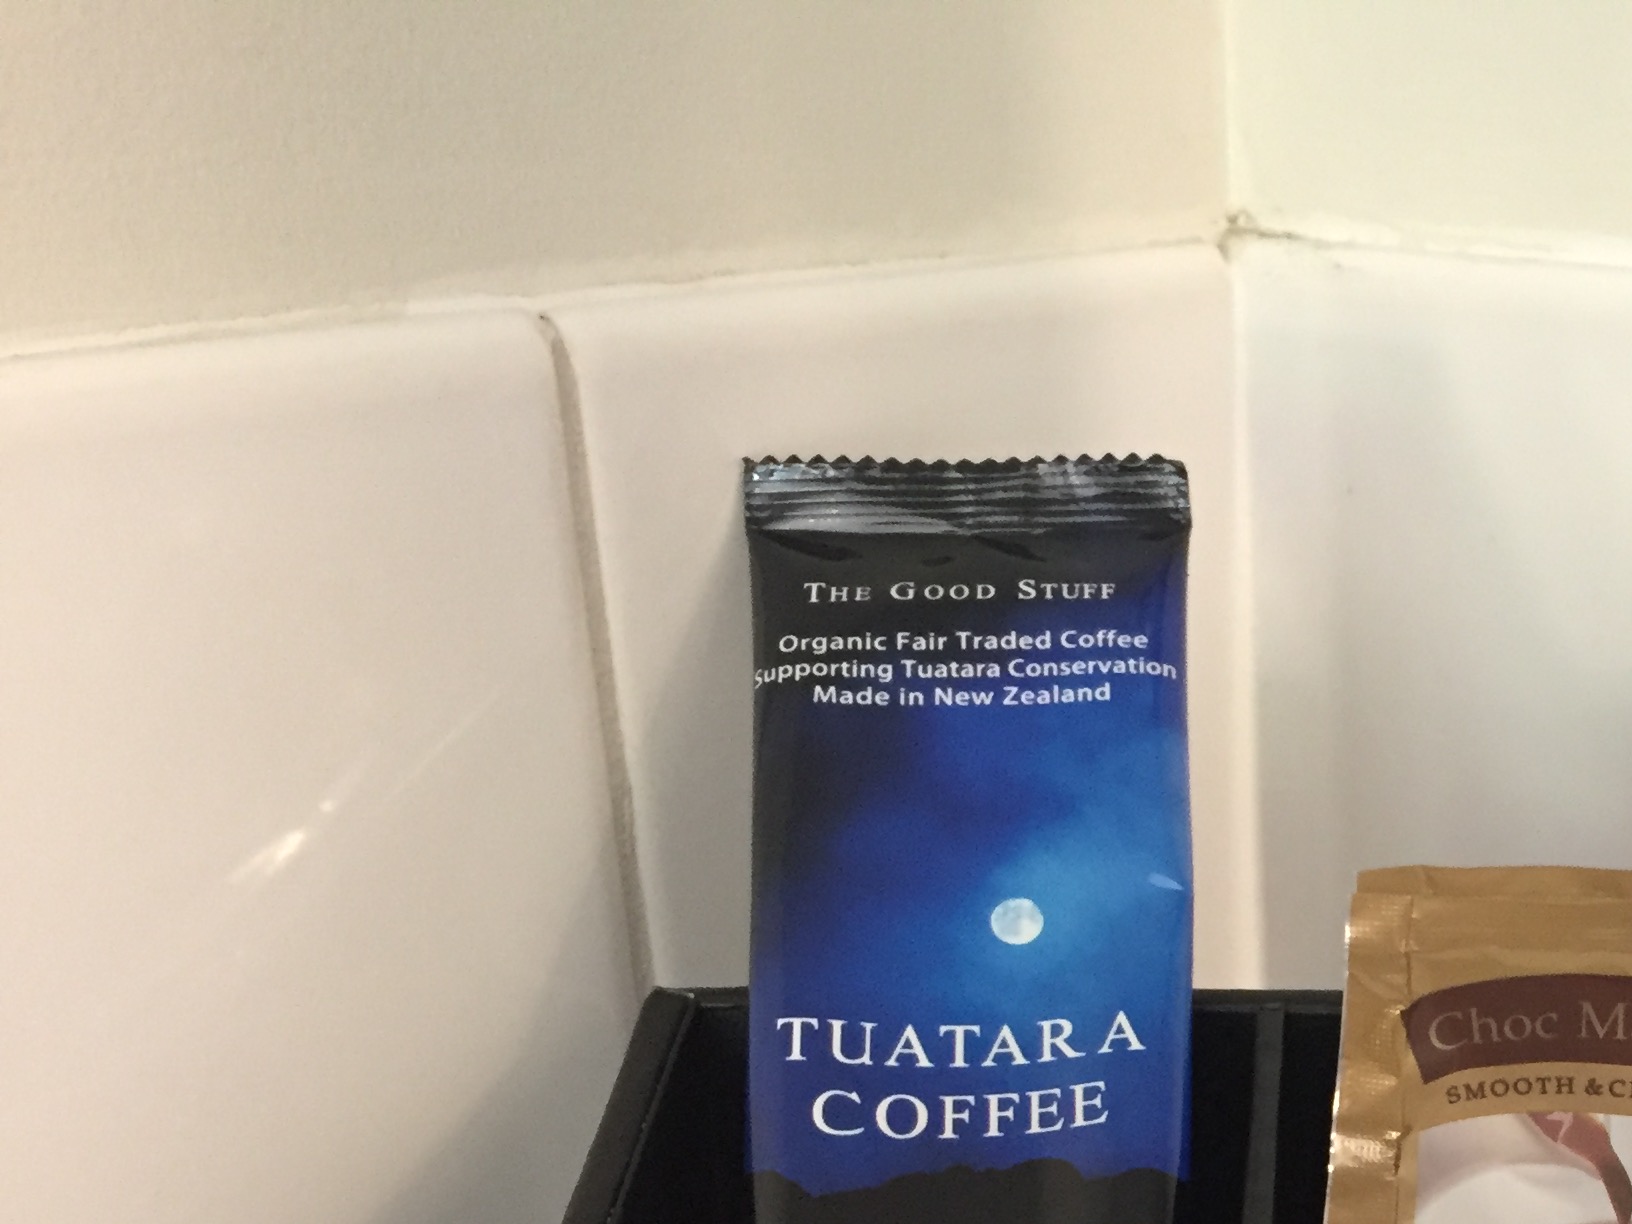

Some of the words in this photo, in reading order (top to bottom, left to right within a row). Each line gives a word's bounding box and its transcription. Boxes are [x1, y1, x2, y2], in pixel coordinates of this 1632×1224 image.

[889, 581, 997, 601] GOOD
[1016, 578, 1117, 601] STUFF
[778, 631, 888, 655] Organic
[896, 631, 949, 653] Fair
[955, 630, 1052, 652] Traded
[1060, 629, 1150, 651] Coffee
[754, 659, 894, 689] Supporting
[901, 658, 1001, 680] Tuatara
[1007, 657, 1178, 680] Conservation
[812, 685, 890, 707] Made
[899, 686, 925, 708] in
[934, 687, 994, 707] New
[1002, 682, 1112, 706] Zealand
[776, 1010, 1146, 1069] TUATARA
[1428, 1004, 1558, 1052] Choc
[1446, 1076, 1575, 1105] SMOOTH
[1585, 1076, 1604, 1097] &
[812, 1080, 1109, 1139] COFFEE
